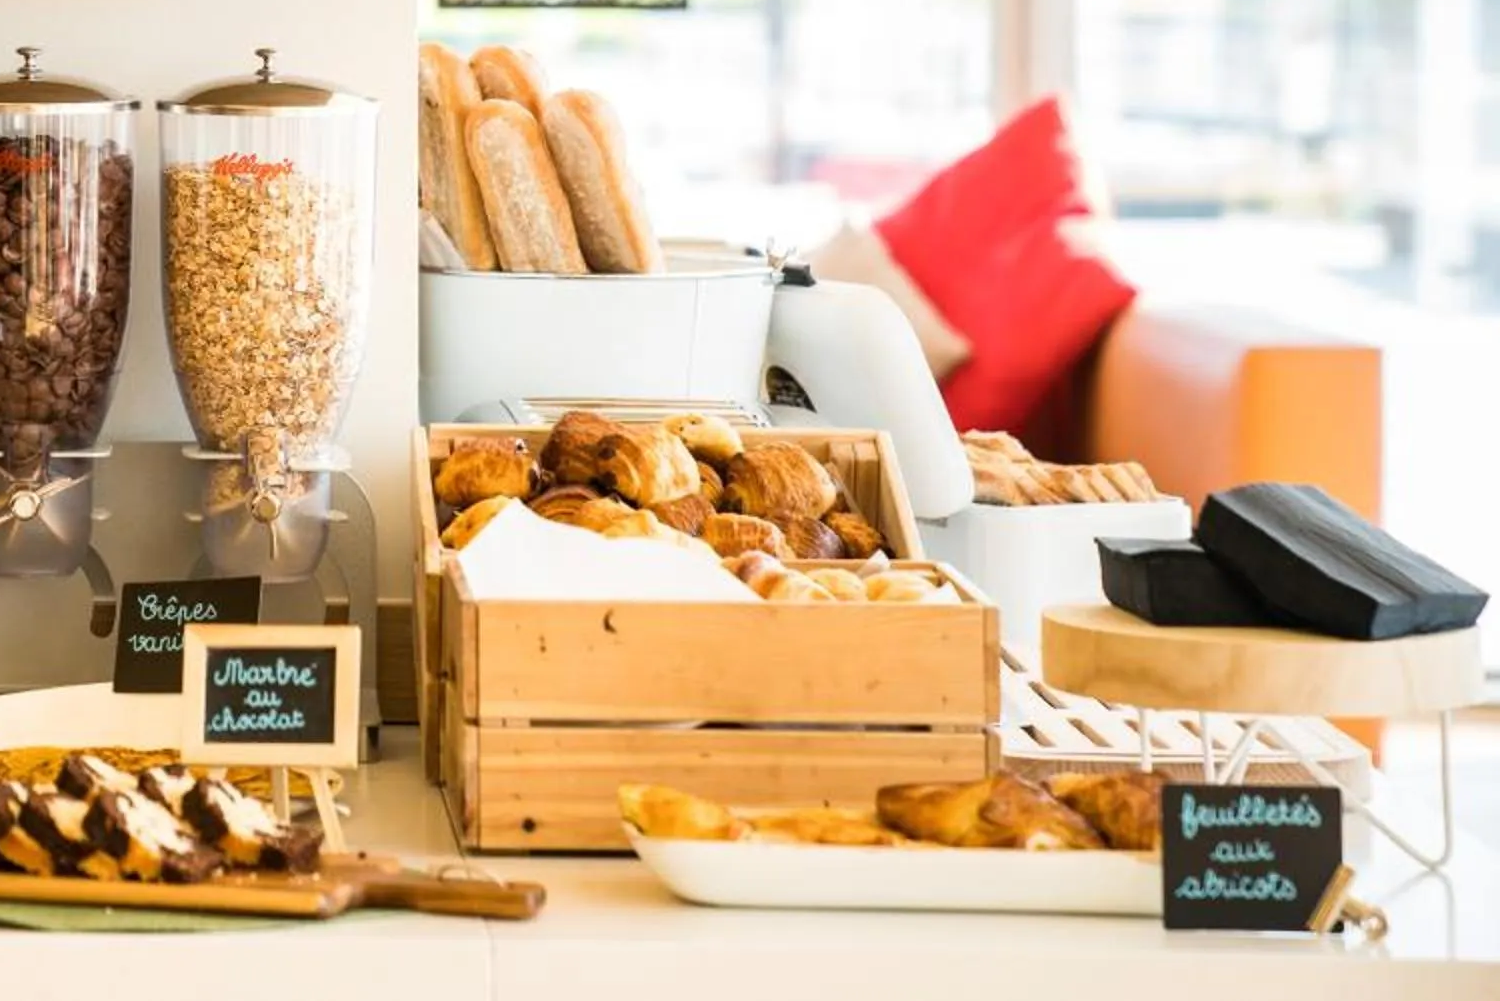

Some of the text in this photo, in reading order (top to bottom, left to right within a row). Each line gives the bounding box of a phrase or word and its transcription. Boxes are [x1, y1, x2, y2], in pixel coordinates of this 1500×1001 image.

[137, 594, 218, 626] Crêpes
[127, 632, 184, 653] vani
[244, 689, 282, 707] au
[206, 707, 306, 732] chocolat
[1209, 840, 1275, 863] aux
[1174, 869, 1298, 900] abricots
